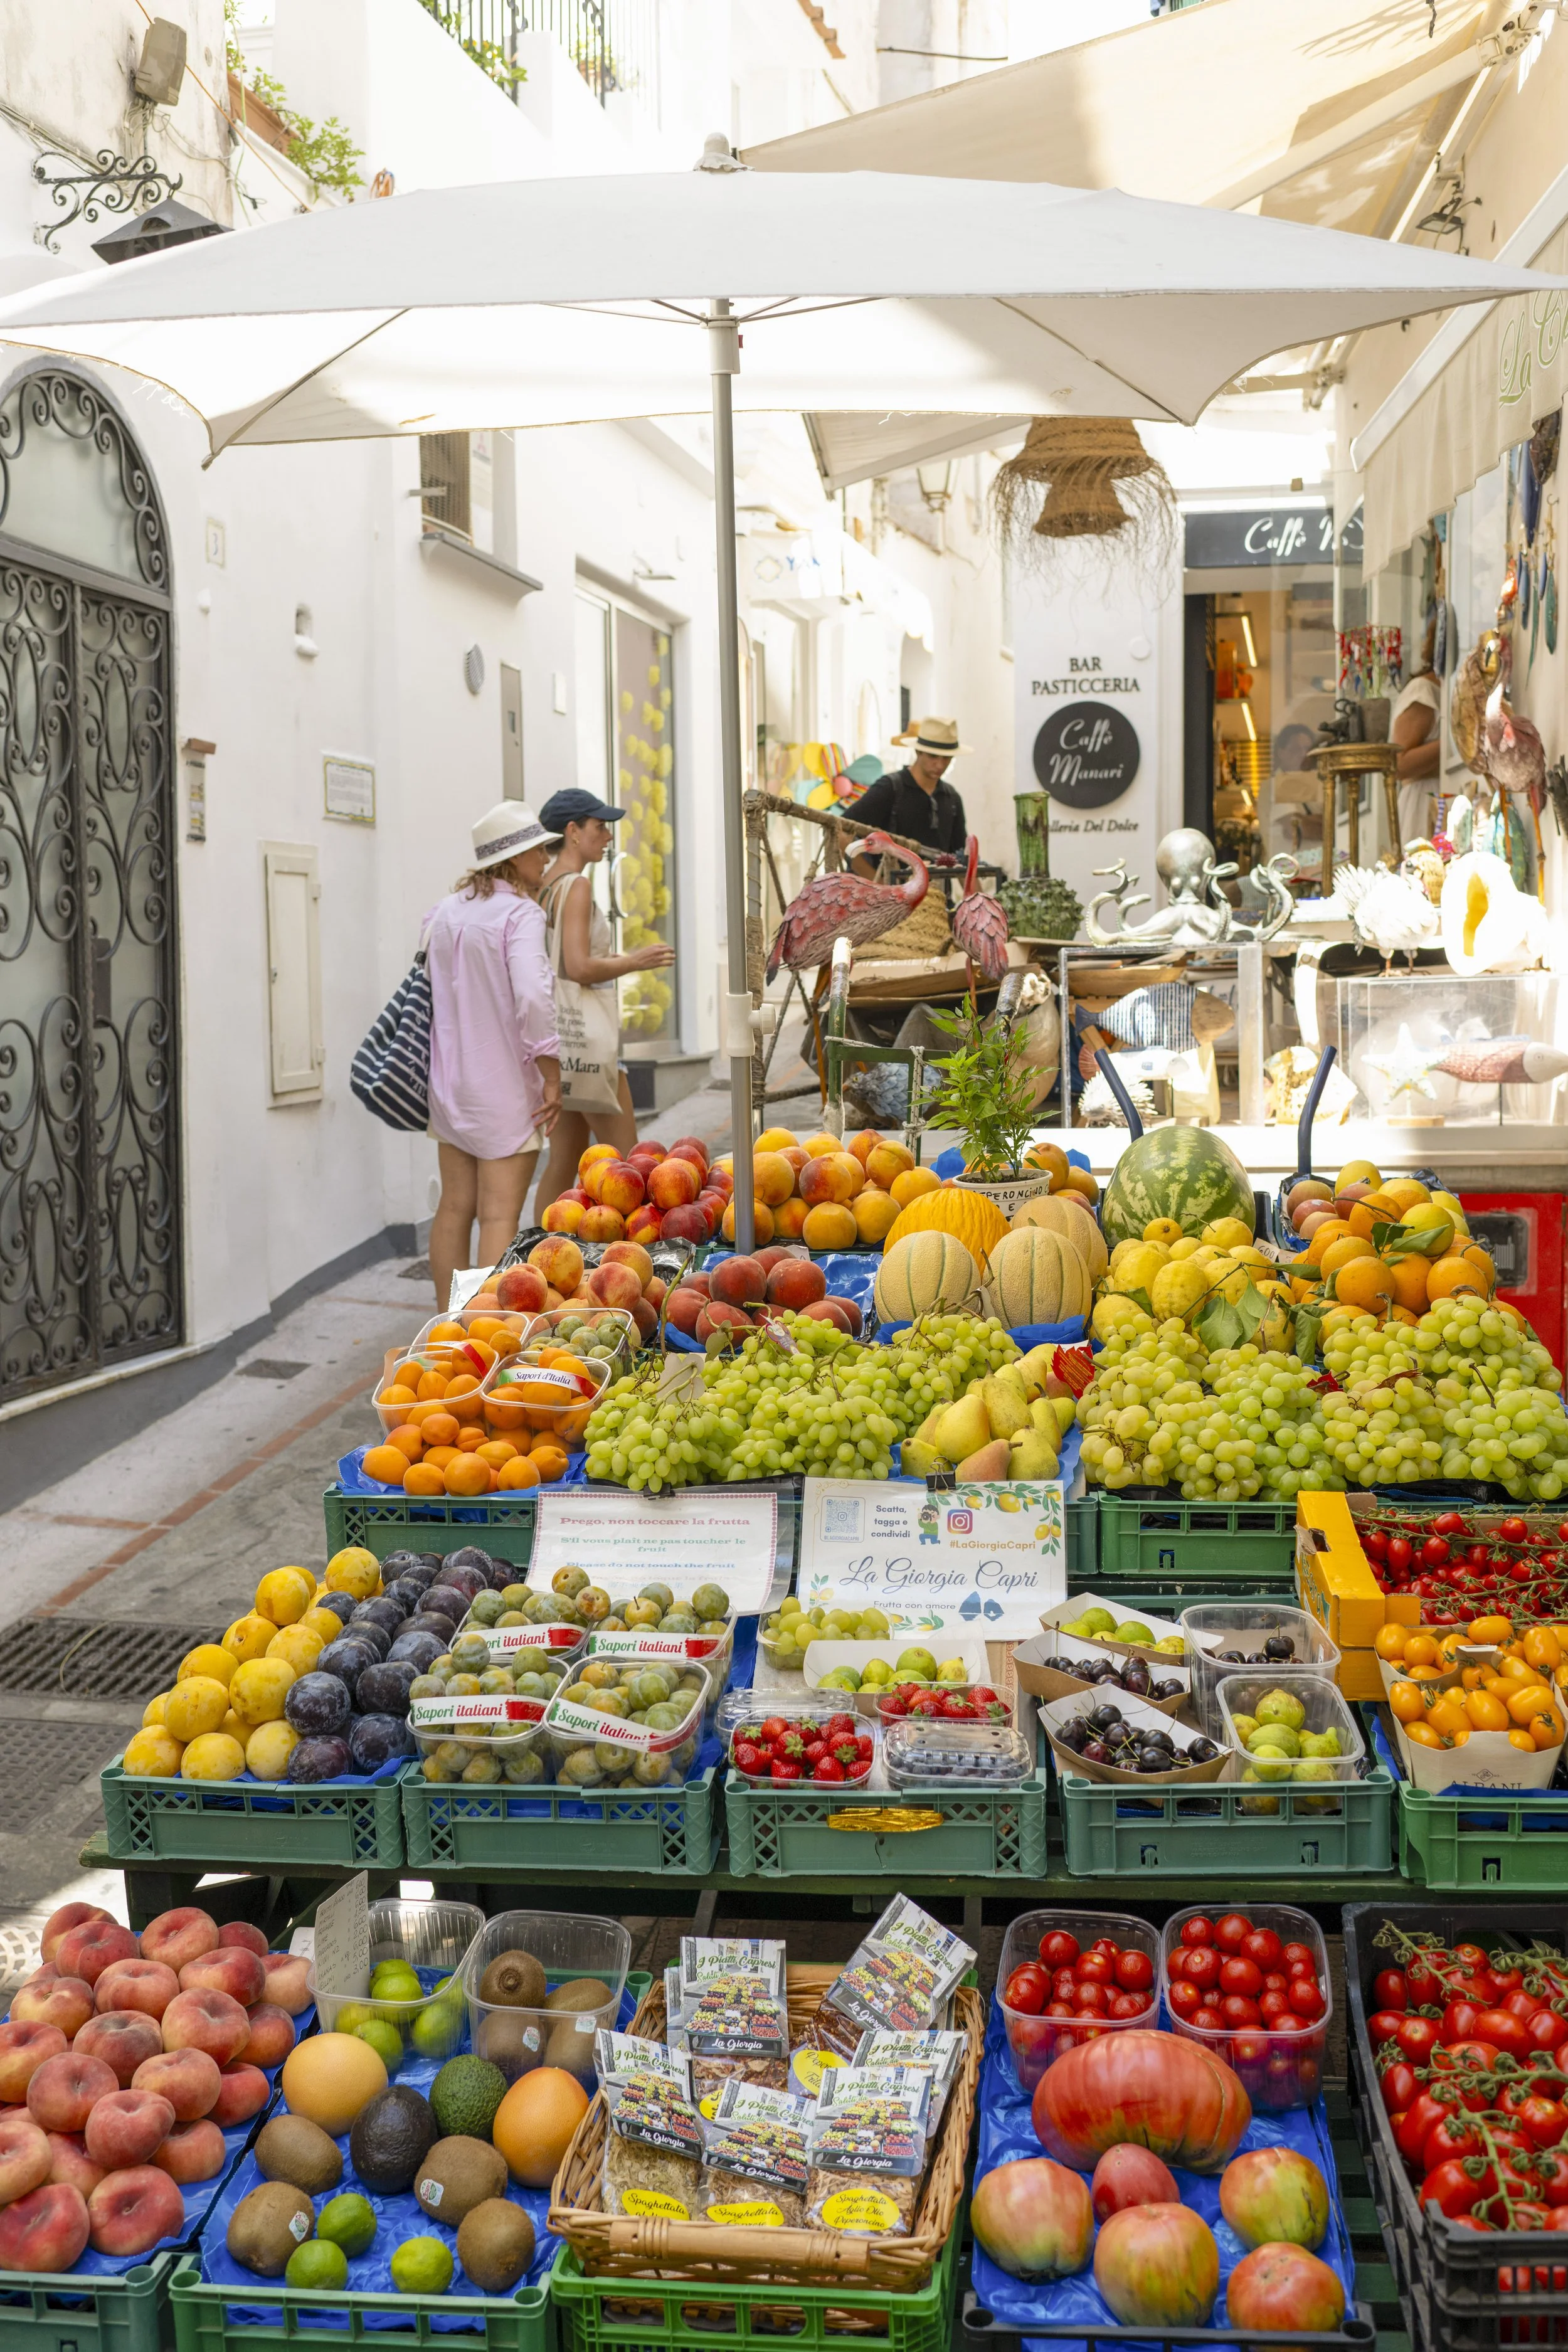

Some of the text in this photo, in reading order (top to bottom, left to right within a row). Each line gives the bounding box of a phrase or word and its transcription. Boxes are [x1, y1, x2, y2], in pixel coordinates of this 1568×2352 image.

[1244, 516, 1306, 557] Caffè
[1069, 657, 1102, 672] BAR
[1032, 678, 1140, 695] PASTICCERIA
[1059, 719, 1113, 753] Caffè
[1049, 753, 1125, 786] Manari
[1049, 818, 1139, 833] alleria Del Dolce
[560, 1056, 600, 1073] xMara
[515, 1372, 571, 1384] Sapori d'Italia
[876, 1505, 907, 1514] Scatta,
[559, 1518, 605, 1526] Prego,
[874, 1518, 900, 1527] tagga
[613, 1537, 641, 1545] plaît
[871, 1530, 911, 1539] condividi
[950, 1540, 1036, 1552] #LaGiorgiaCapri
[839, 1555, 1039, 1594] La Giorgia Capri
[874, 1601, 902, 1609] Frutta
[487, 1632, 546, 1650] ori italiani
[598, 1638, 683, 1655] Sapori italiani
[415, 1703, 502, 1721] Sapori italiani
[558, 1709, 599, 1734] Sapori
[904, 1926, 930, 1947] Piatti
[926, 1944, 957, 1974] Capresi
[708, 1955, 737, 1966] Piatti
[738, 1956, 776, 1969] Capresi
[848, 2001, 860, 2015] La
[712, 2038, 763, 2052] La Giorgia
[882, 2043, 911, 2053] Piatti
[912, 2044, 949, 2055] Capresi
[624, 2050, 650, 2063] Piatti
[651, 2058, 686, 2076] Capresi
[848, 2081, 879, 2092] Piatti
[880, 2082, 920, 2094] Capresi
[748, 2101, 778, 2113] Piatti
[778, 2110, 814, 2126] Capres
[640, 2129, 686, 2148] La Giorgia
[837, 2155, 893, 2168] La Giorgia
[731, 2163, 785, 2182] La Giorgia
[628, 2193, 686, 2215] Spaghettata
[836, 2193, 887, 2205] Spaghettata
[714, 2206, 780, 2218] Spaghettata
[836, 2205, 884, 2216] Aglio Olio
[834, 2215, 885, 2228] Peperoncino
